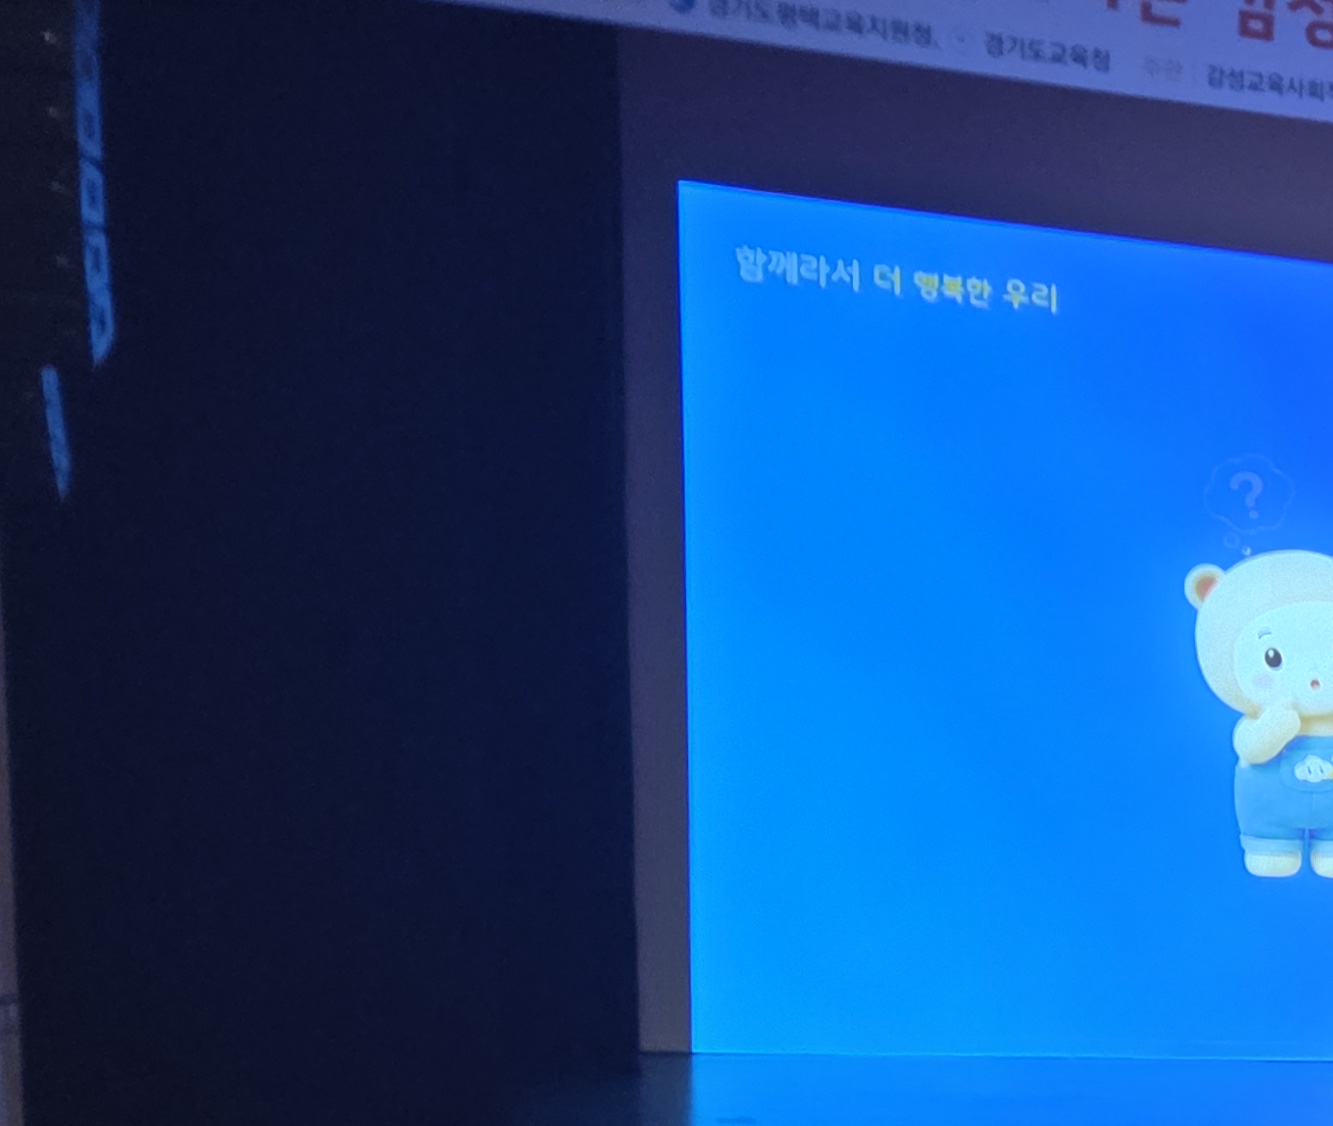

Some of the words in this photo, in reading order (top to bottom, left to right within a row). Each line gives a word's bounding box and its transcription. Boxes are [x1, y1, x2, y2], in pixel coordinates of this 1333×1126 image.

[984, 31, 1110, 73] 경기도교육청
[735, 245, 860, 292] 함께라서
[873, 264, 901, 296] 더
[913, 270, 992, 309] 행복한
[1003, 278, 1057, 315] 우리
